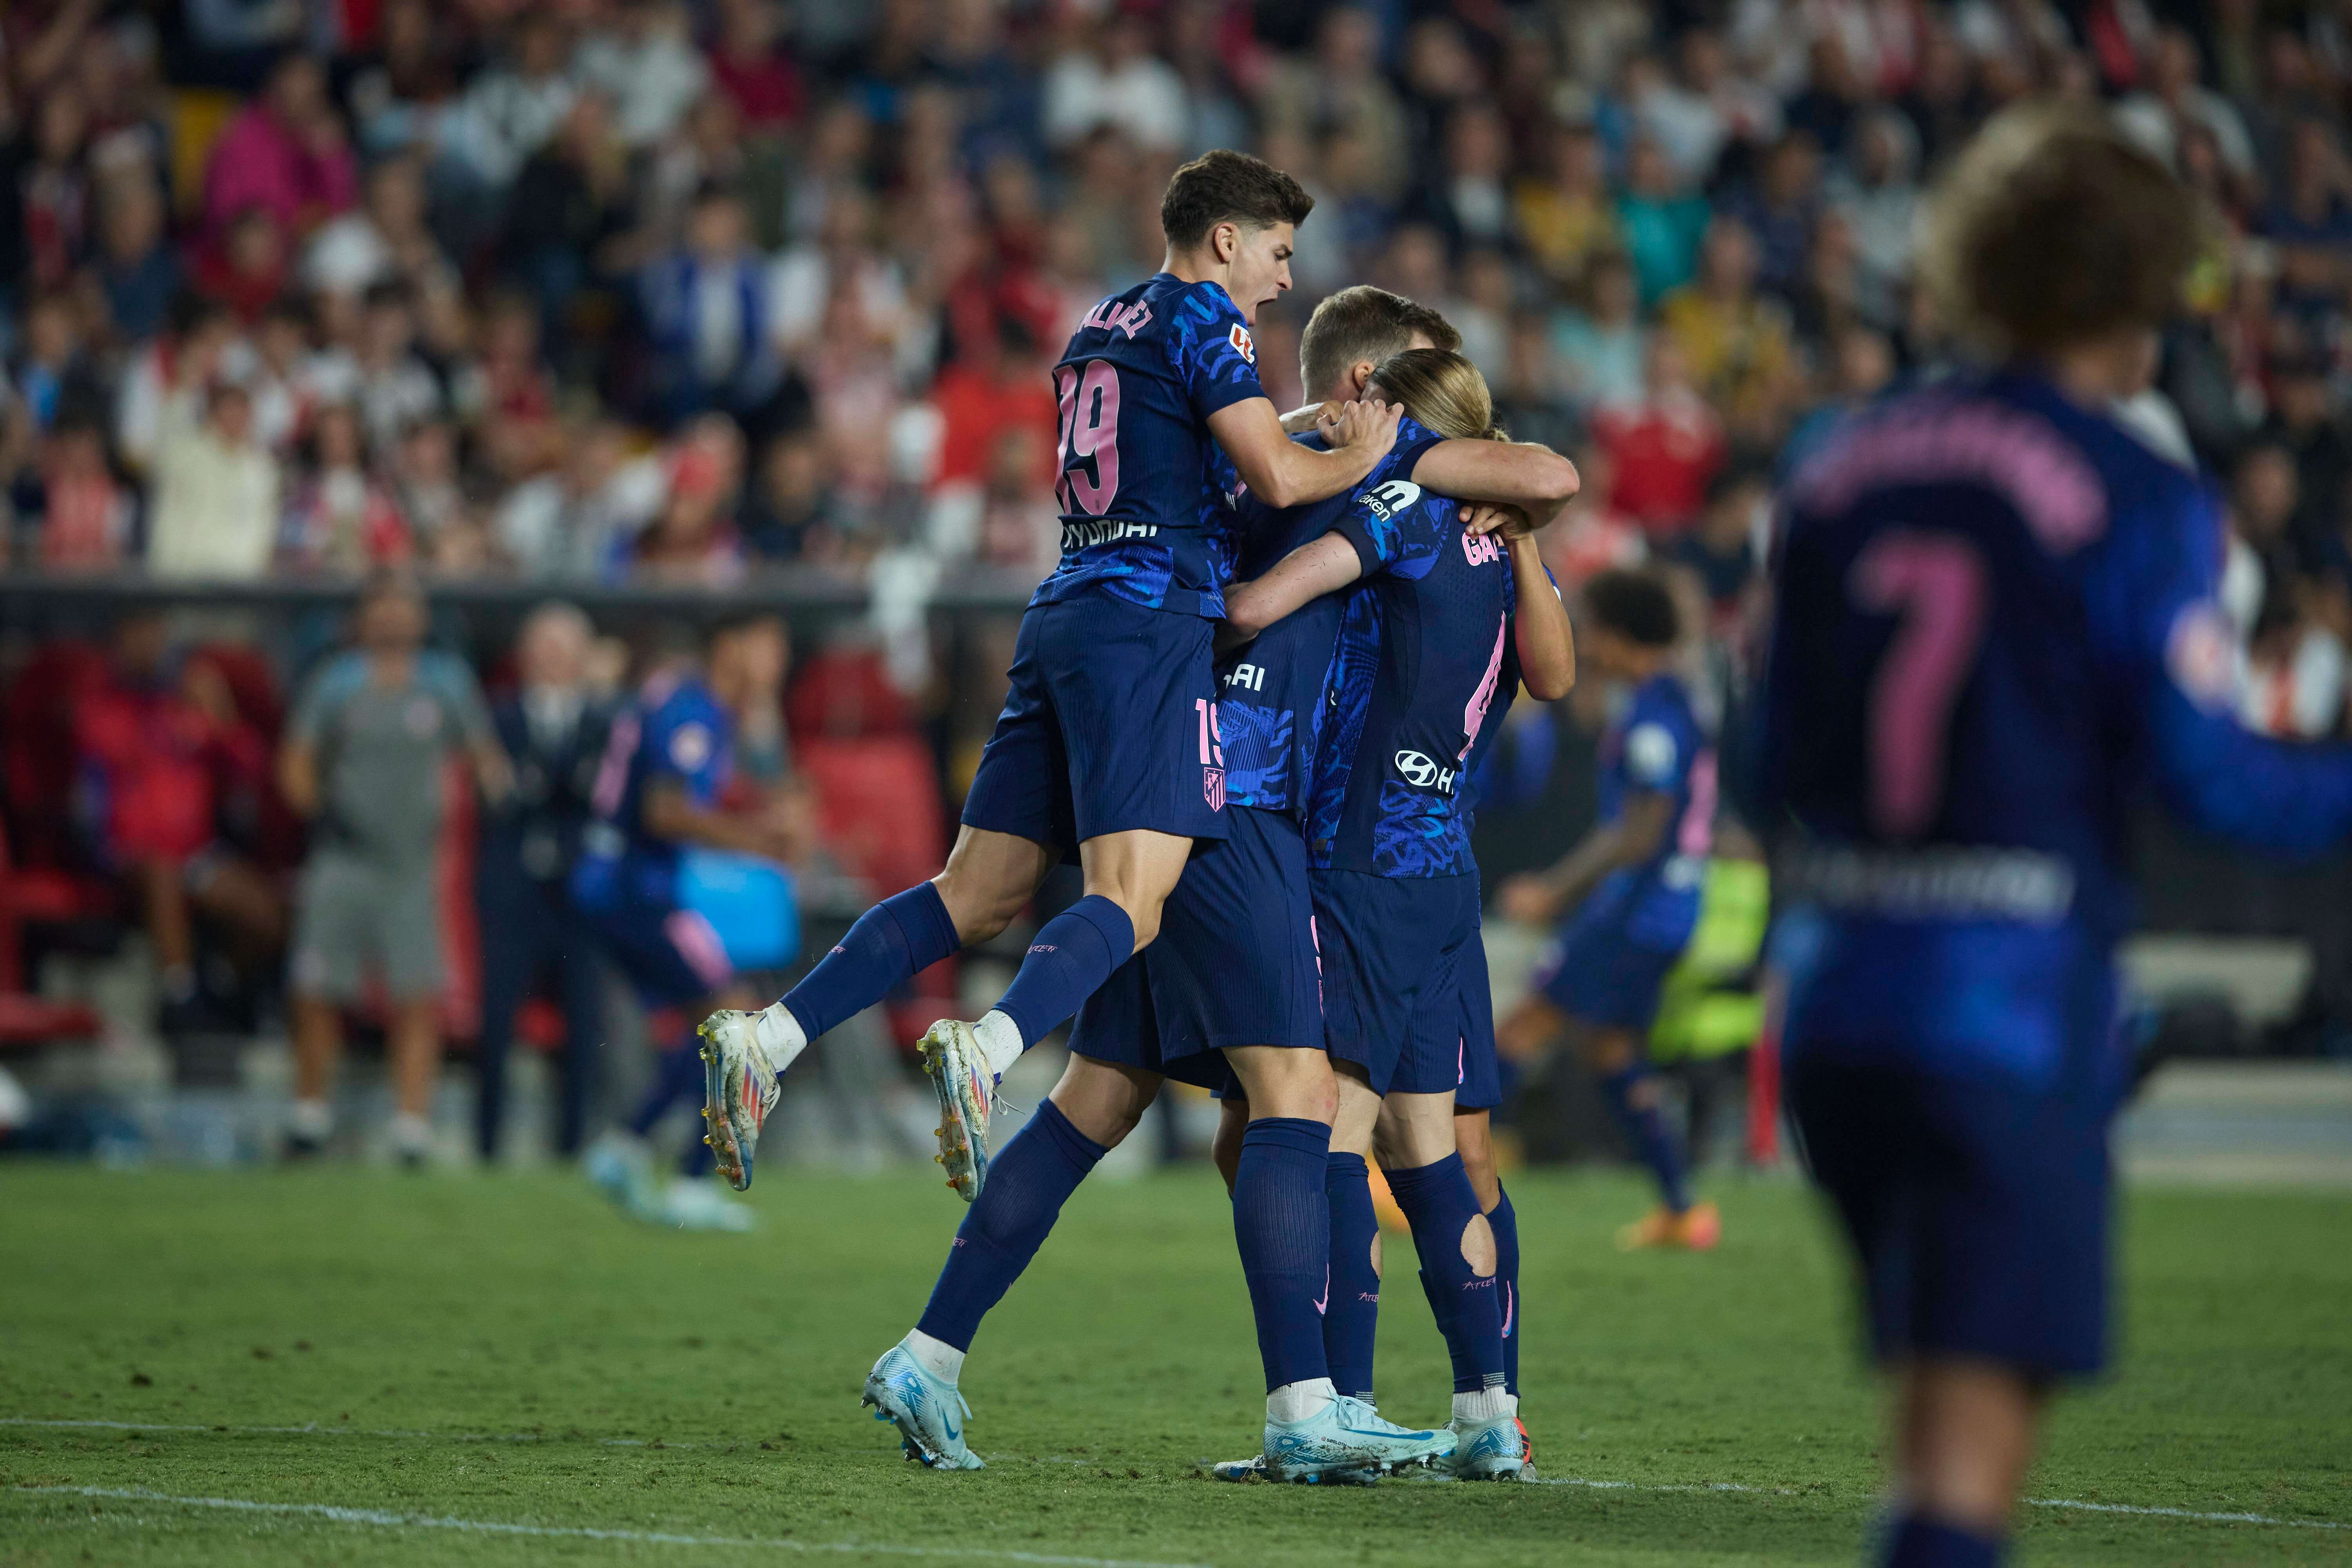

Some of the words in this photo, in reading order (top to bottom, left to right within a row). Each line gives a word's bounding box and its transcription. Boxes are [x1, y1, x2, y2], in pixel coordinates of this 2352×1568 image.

[1054, 359, 1120, 515] 19
[1359, 494, 1391, 523] aken
[1462, 531, 1499, 566] GA
[1223, 663, 1265, 691] AI
